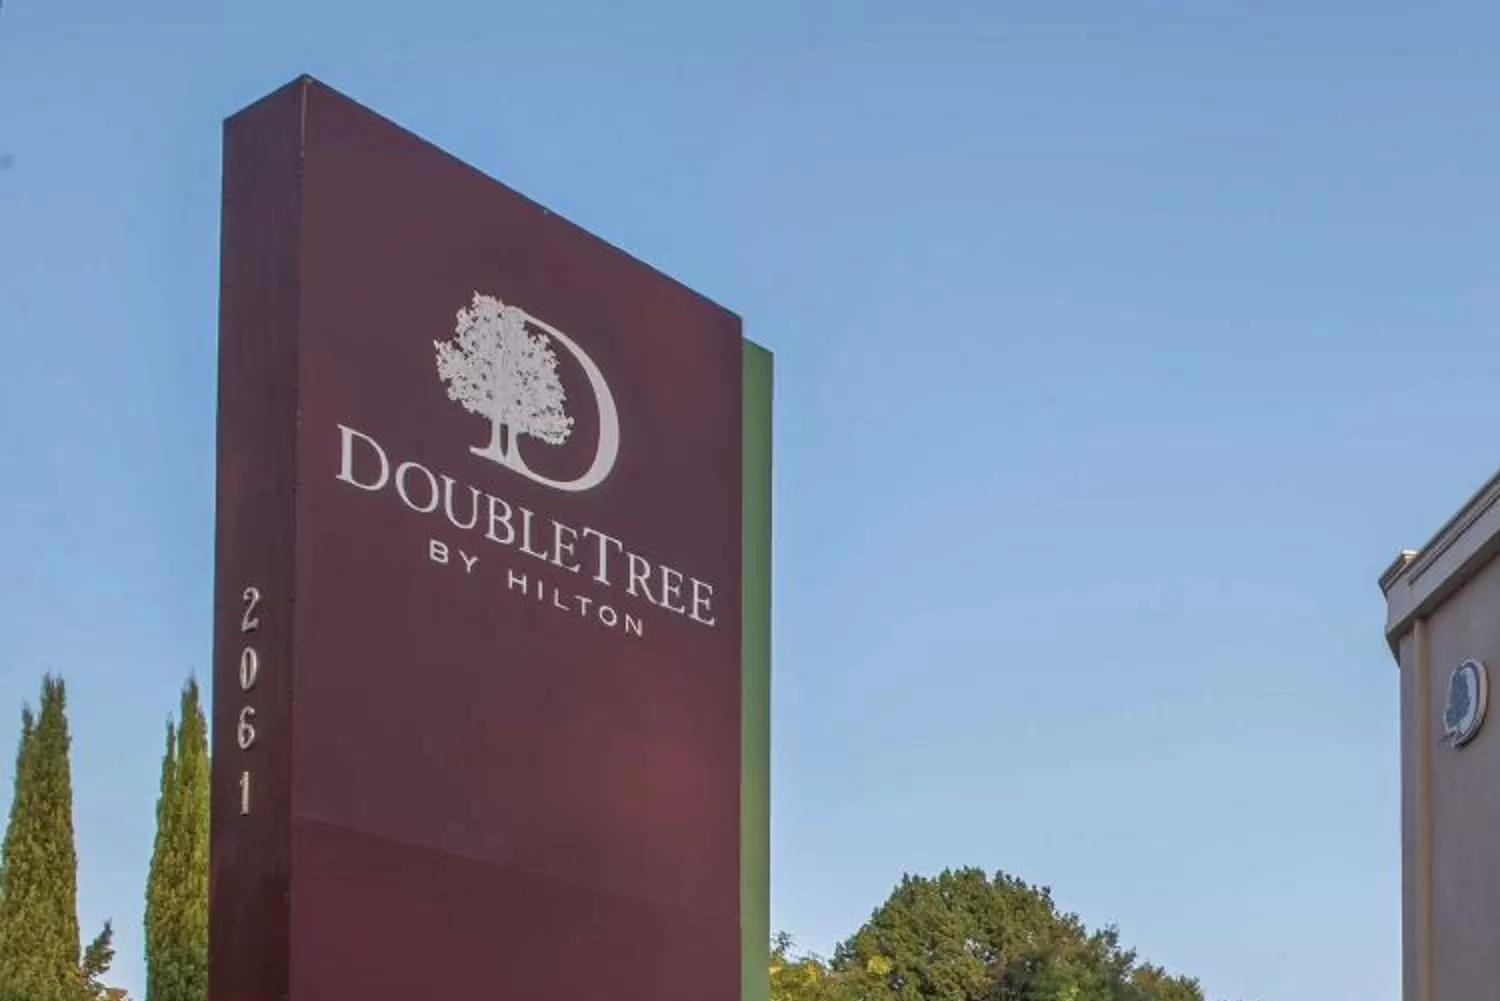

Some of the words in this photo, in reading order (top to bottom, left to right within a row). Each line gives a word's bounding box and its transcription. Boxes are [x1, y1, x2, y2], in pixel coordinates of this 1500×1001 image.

[335, 423, 716, 627] DOUBLETREE
[429, 539, 479, 573] BY
[507, 568, 643, 637] HILTON
[237, 586, 261, 816] 2061
